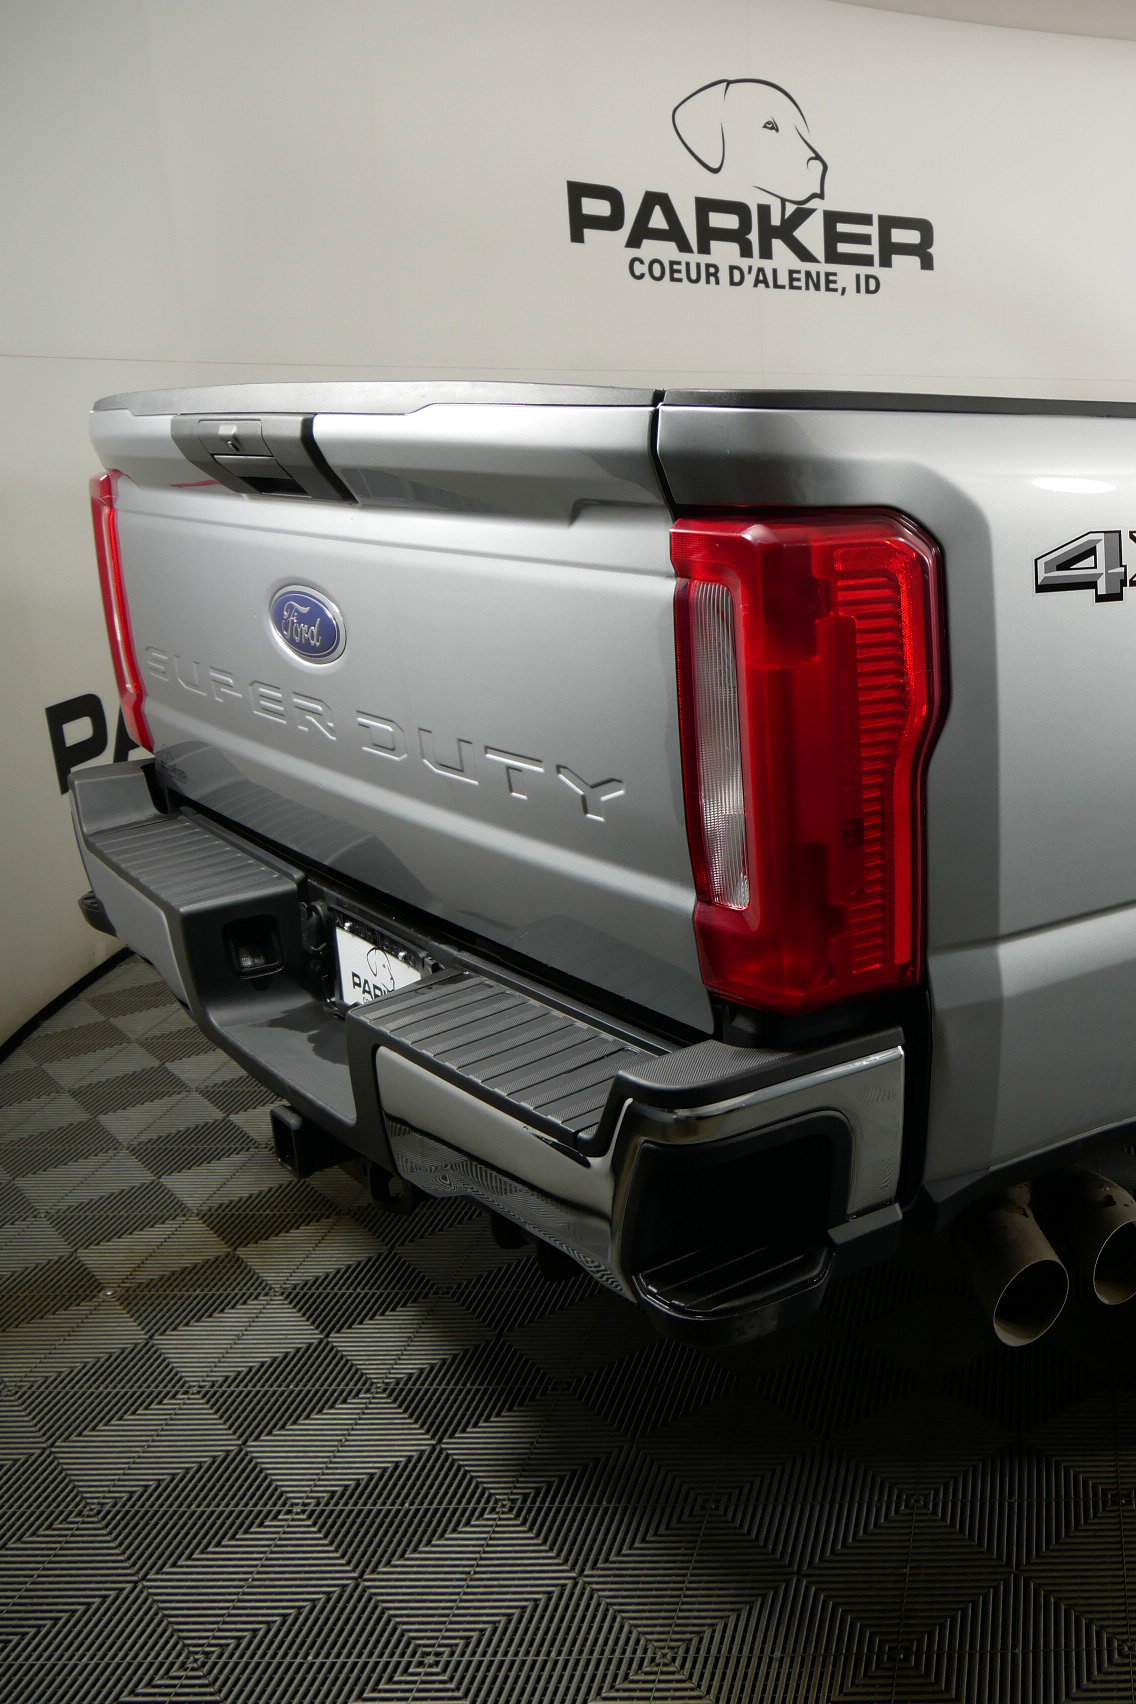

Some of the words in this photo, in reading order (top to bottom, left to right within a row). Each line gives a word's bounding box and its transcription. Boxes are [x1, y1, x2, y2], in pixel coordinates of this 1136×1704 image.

[566, 180, 935, 271] PARKER
[628, 256, 720, 286] COEUR
[729, 264, 846, 296] D'ALENE,
[855, 273, 881, 295] ID
[281, 600, 322, 648] Ford
[145, 646, 337, 741] SUPER
[356, 709, 625, 822] DUTY
